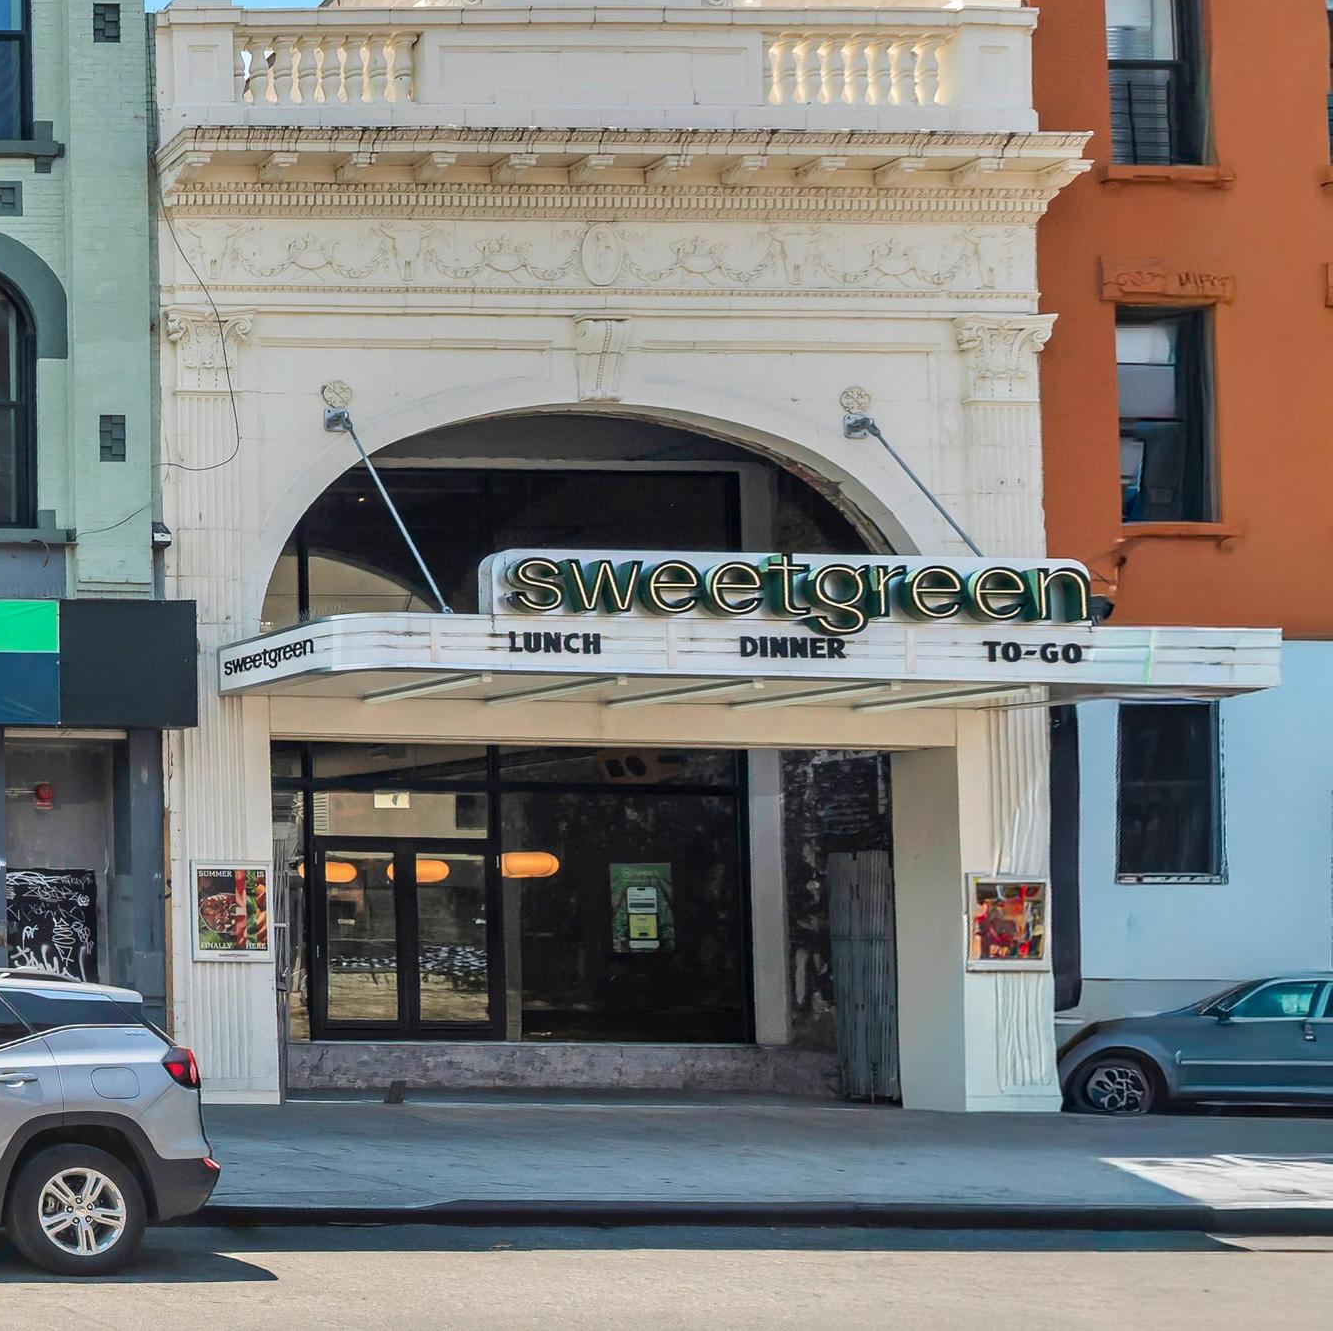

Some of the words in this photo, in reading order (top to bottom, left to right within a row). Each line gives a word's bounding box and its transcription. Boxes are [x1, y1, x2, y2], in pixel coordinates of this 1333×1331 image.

[506, 553, 1091, 636] sweetgreen
[224, 639, 315, 676] sweetgreen
[508, 631, 602, 655] LUNCH
[739, 636, 847, 659] DINNER
[983, 640, 1083, 664] TO-GO
[198, 870, 233, 878] SUMMER
[199, 942, 233, 950] FINALLY
[246, 942, 267, 950] HERE
